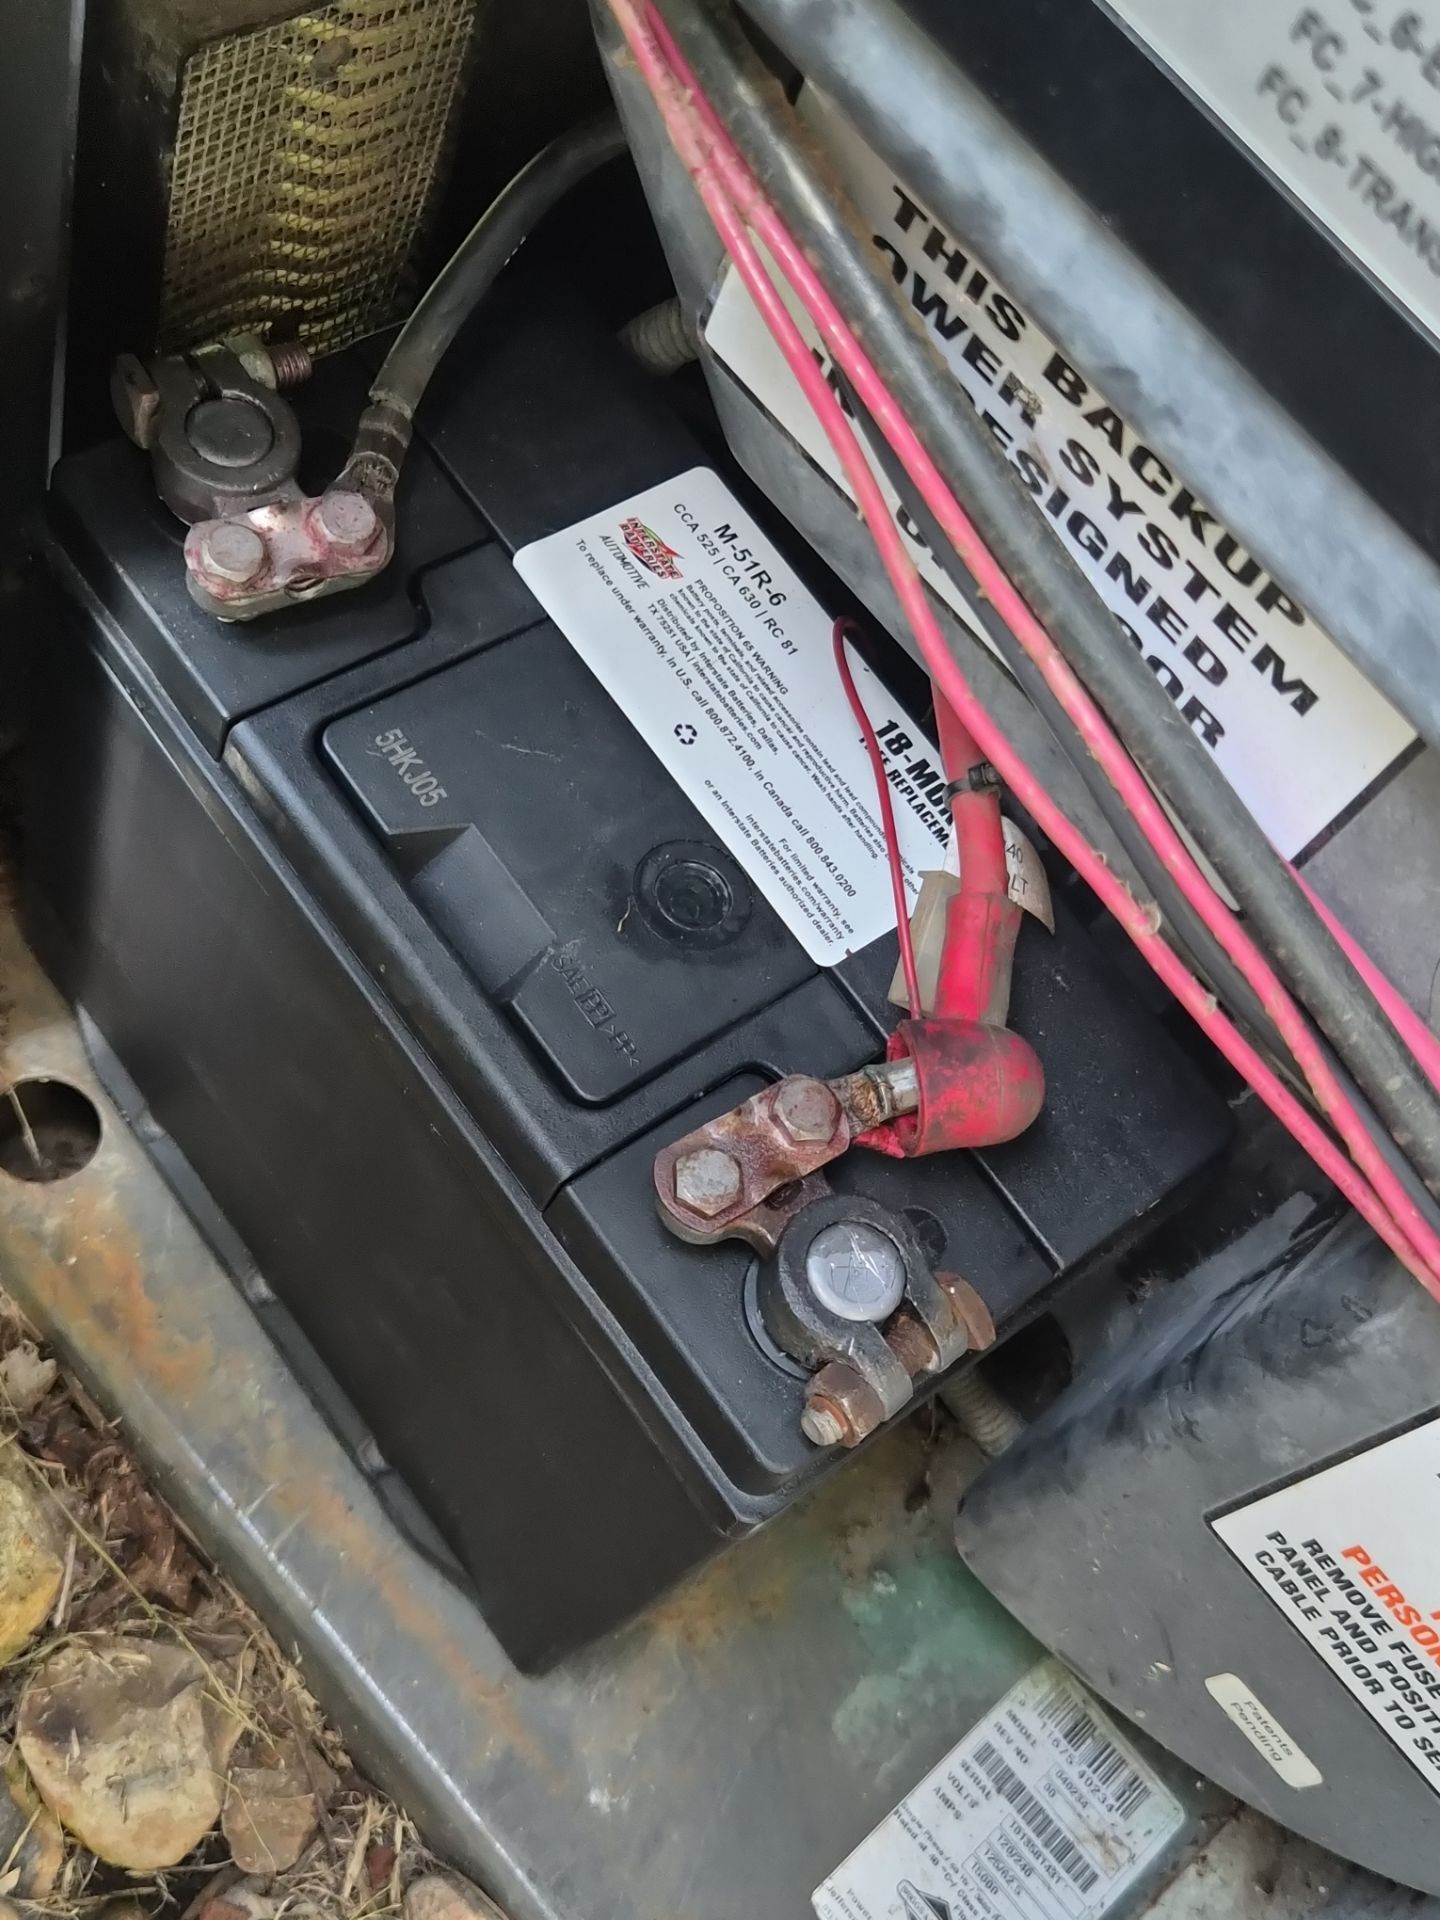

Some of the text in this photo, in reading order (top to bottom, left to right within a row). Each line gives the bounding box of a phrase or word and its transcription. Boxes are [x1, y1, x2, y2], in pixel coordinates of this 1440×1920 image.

[1289, 7, 1440, 184] FC_7-HIG
[872, 235, 1319, 718] OWER SYSTEM
[893, 185, 1305, 627] THIS BACKUP
[598, 535, 649, 589] AUTOMOTIVE
[619, 524, 667, 580] BATTERIES
[628, 518, 681, 580] INTERSTATE
[673, 503, 699, 533] CCA
[696, 533, 720, 556] 525
[722, 565, 741, 586] CA
[738, 585, 761, 609] 630
[762, 617, 784, 638] RC
[780, 639, 798, 655] 81
[713, 523, 786, 606] M-51R-6
[960, 383, 1229, 687] ESIGNED
[647, 603, 659, 615] TX
[655, 614, 677, 638] 75251
[674, 638, 690, 658] USA
[691, 660, 762, 750] interstatebatteries.com
[656, 598, 778, 755] Distributed by Interstate Batteries, Dallas,
[685, 583, 705, 607] Battery
[702, 608, 719, 628] posts,
[719, 627, 744, 660] terminals,
[744, 660, 757, 672] and
[754, 672, 775, 695] related
[772, 695, 804, 733] accessories
[802, 733, 823, 758] contain
[821, 757, 836, 773] lead
[833, 773, 846, 786] and
[843, 785, 858, 801] lead
[693, 578, 788, 695] PROPOSITION 65 WARNING
[375, 729, 447, 807] 5HKJ05
[575, 538, 856, 897] To replace under warranty, in U.S. call 800.872.4100, in Canada call 800.843.0200
[677, 587, 695, 610] known
[694, 609, 701, 617] to
[700, 617, 710, 629] the
[708, 629, 723, 645] state
[721, 645, 731, 653] of
[728, 652, 753, 684] California
[752, 683, 760, 692] to
[758, 692, 775, 712] cause
[774, 712, 793, 734] cancer
[791, 735, 804, 748] and
[801, 747, 835, 788] reproductive
[833, 788, 849, 808] harm.
[848, 807, 873, 837] Batteries
[872, 838, 885, 852] also
[704, 779, 833, 946] or an Interstate Batteries authorized dealer.
[745, 813, 844, 939] interstatebatteries.com/warranty
[777, 837, 854, 933] For limited warranty, see
[1255, 1550, 1440, 1771] CABLE PRIOR TO SE
[1265, 1530, 1332, 1603] PANEL
[1330, 1609, 1378, 1655] AND
[1301, 1538, 1440, 1700] REMOVE FUSE
[1230, 1701, 1283, 1763] Pending
[1243, 1700, 1293, 1756] Patents
